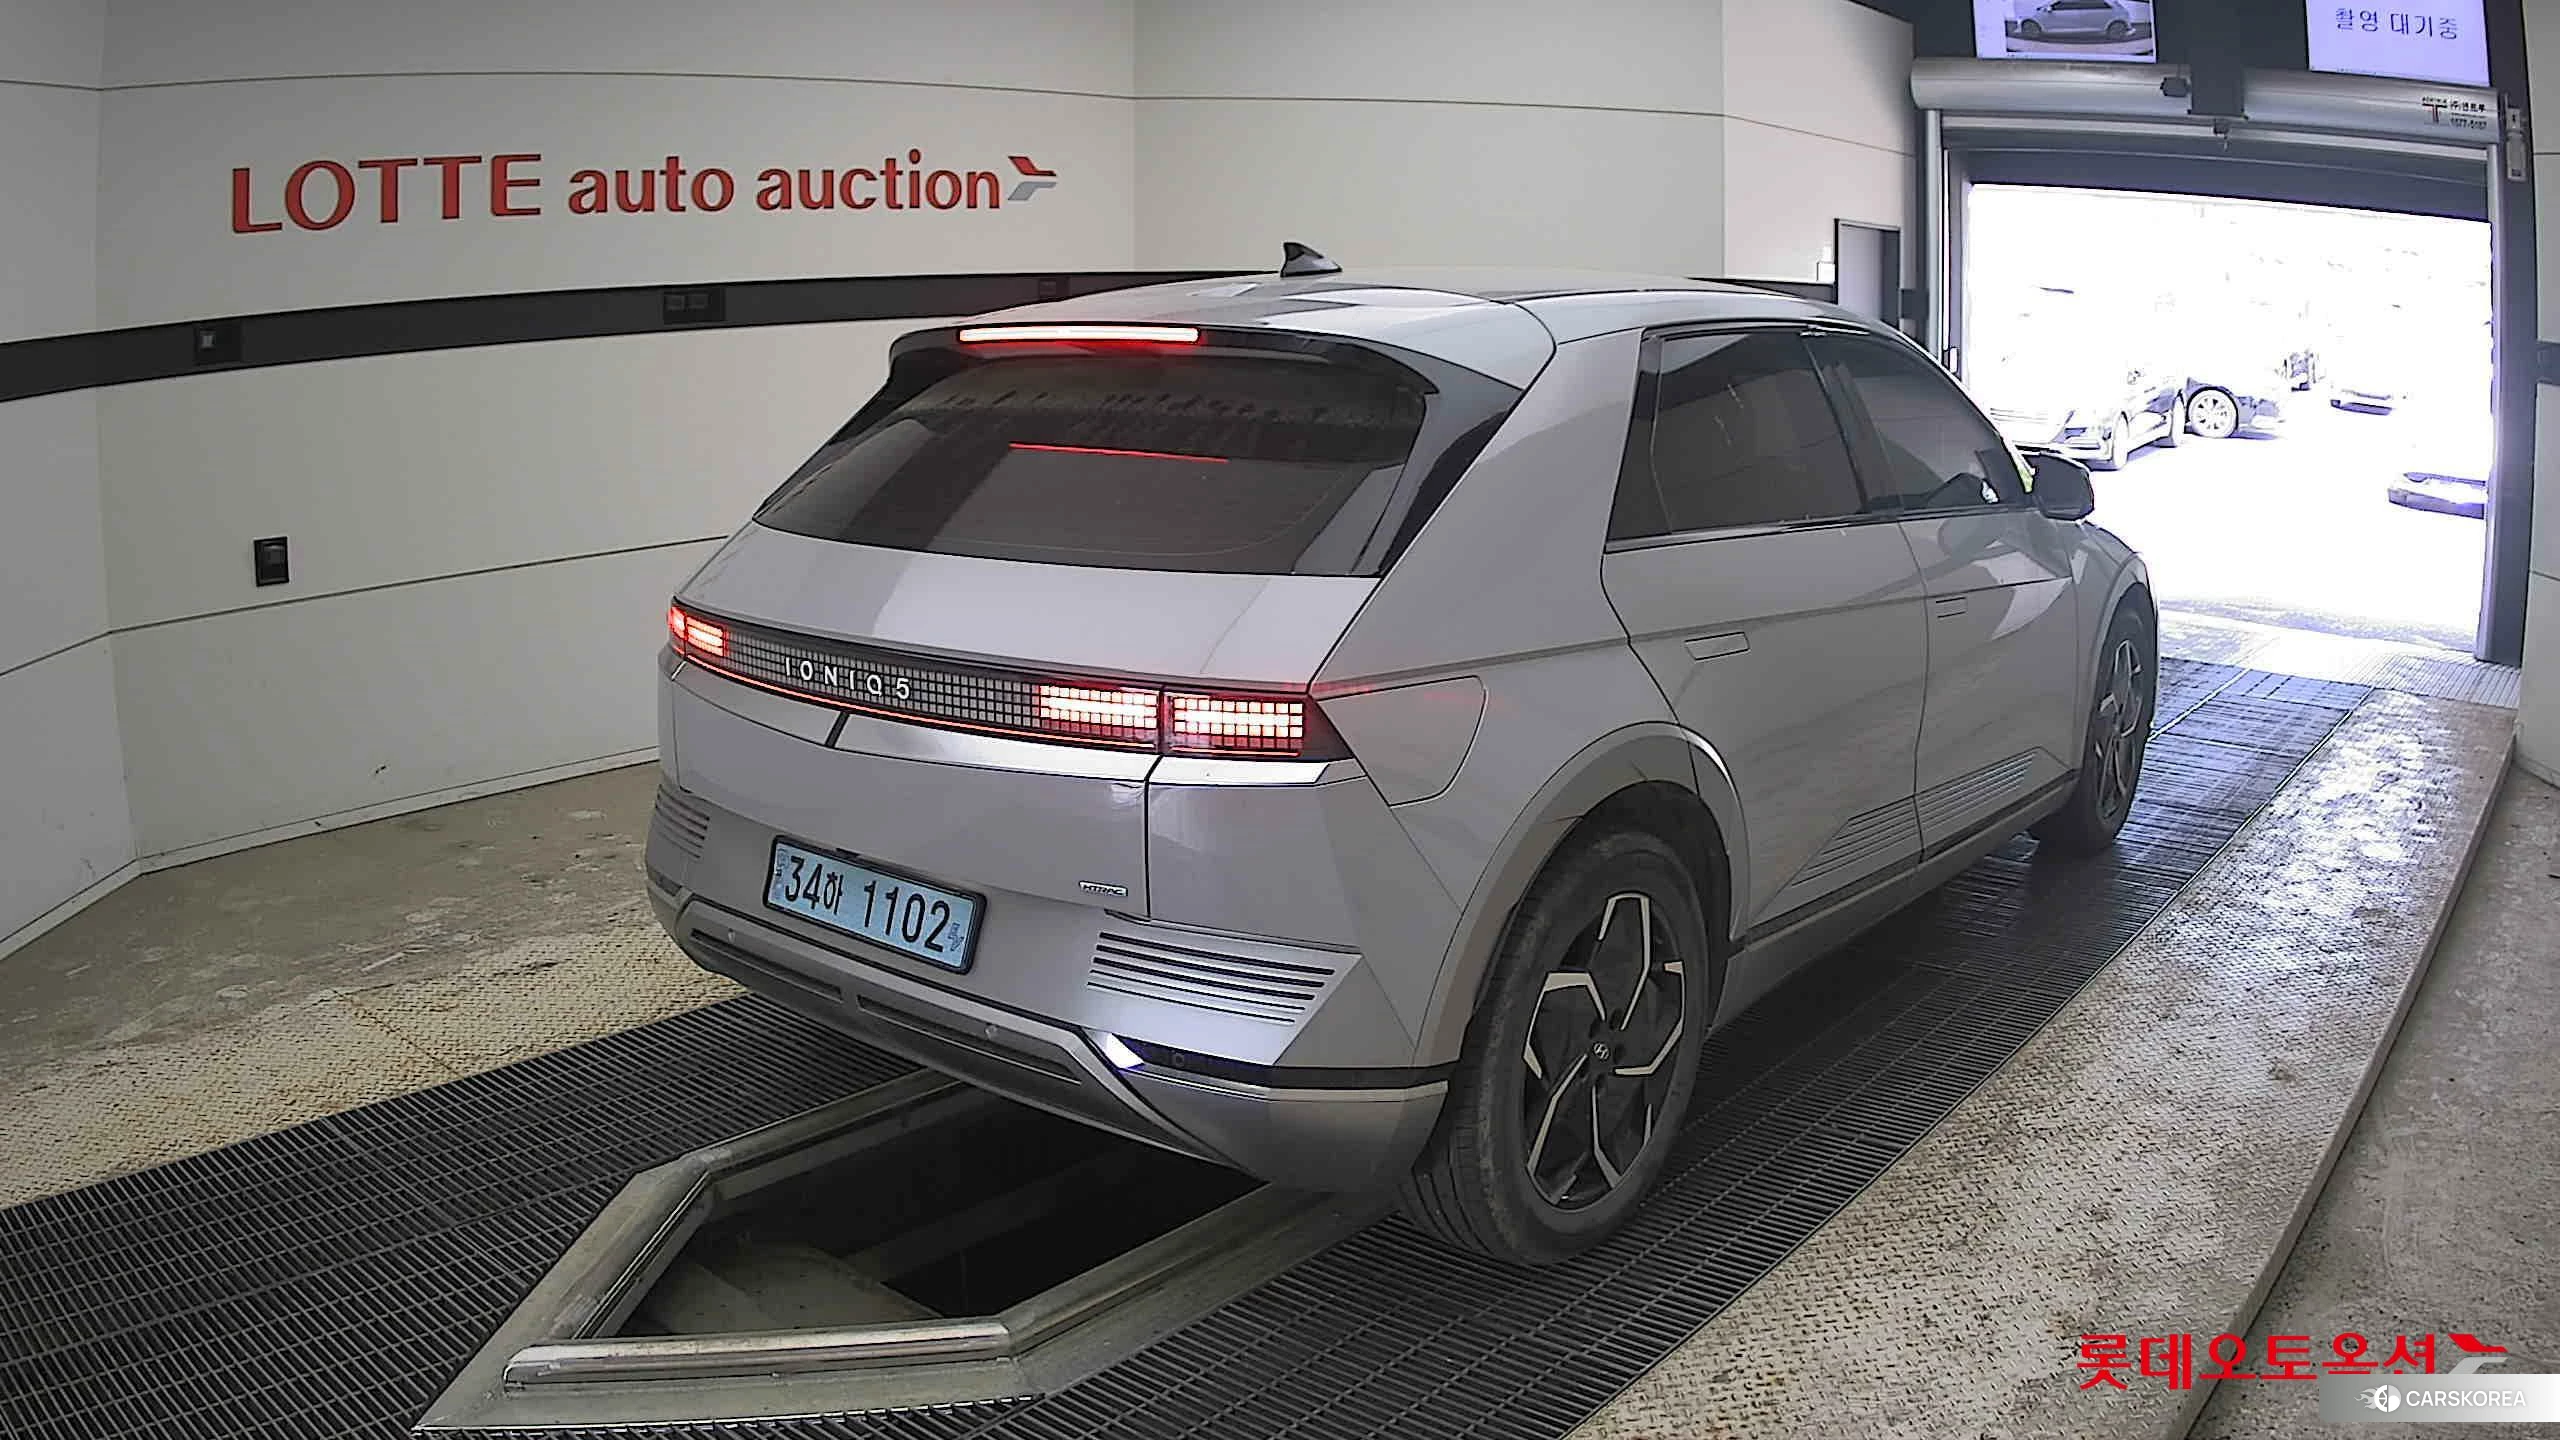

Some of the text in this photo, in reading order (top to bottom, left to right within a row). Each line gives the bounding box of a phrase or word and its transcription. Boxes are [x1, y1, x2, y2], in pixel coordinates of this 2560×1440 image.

[2336, 7, 2379, 33] 촬영
[232, 147, 1001, 234] LOTTE auto auction
[785, 656, 910, 700] IONIQ 5
[784, 855, 845, 916] 34하
[863, 879, 951, 953] 1102
